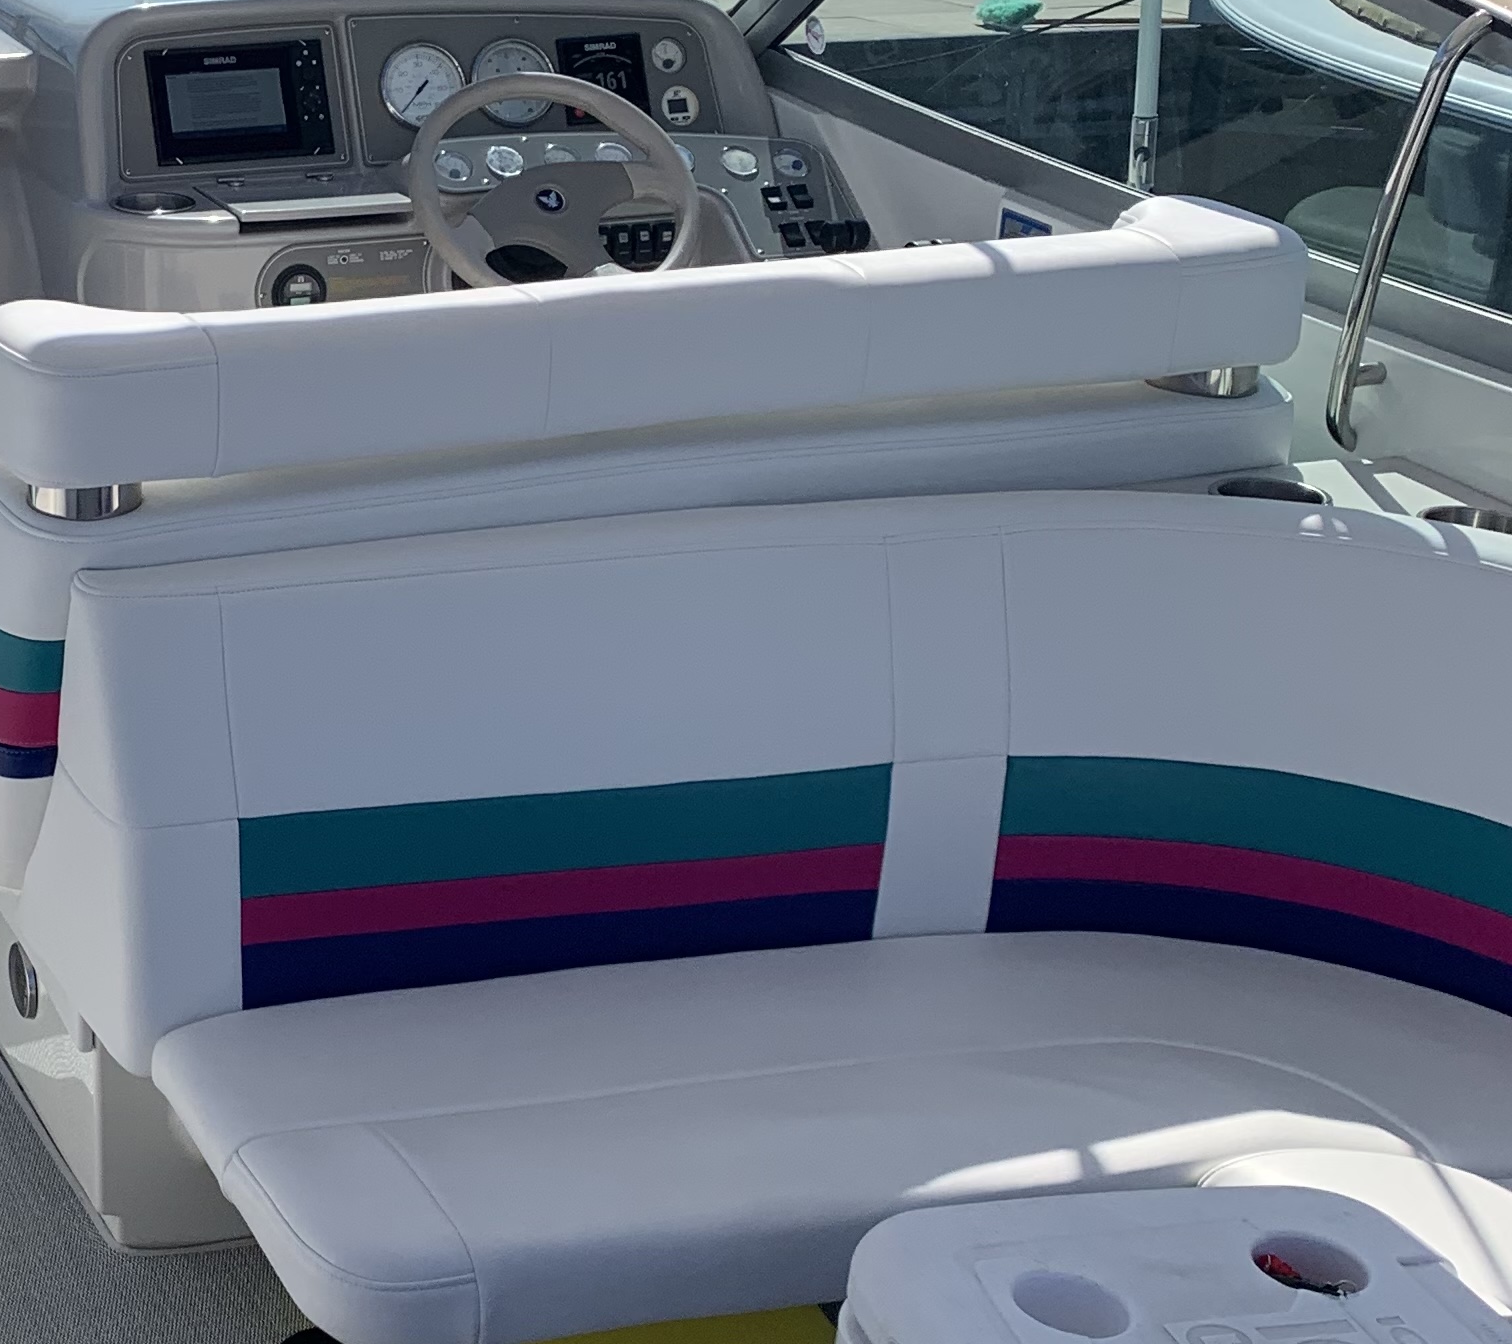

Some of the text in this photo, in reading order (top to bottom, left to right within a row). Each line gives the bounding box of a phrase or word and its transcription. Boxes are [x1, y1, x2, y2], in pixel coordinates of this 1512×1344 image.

[584, 41, 617, 52] SIMRAD
[203, 56, 237, 66] SIMRAD
[595, 70, 627, 90] 161
